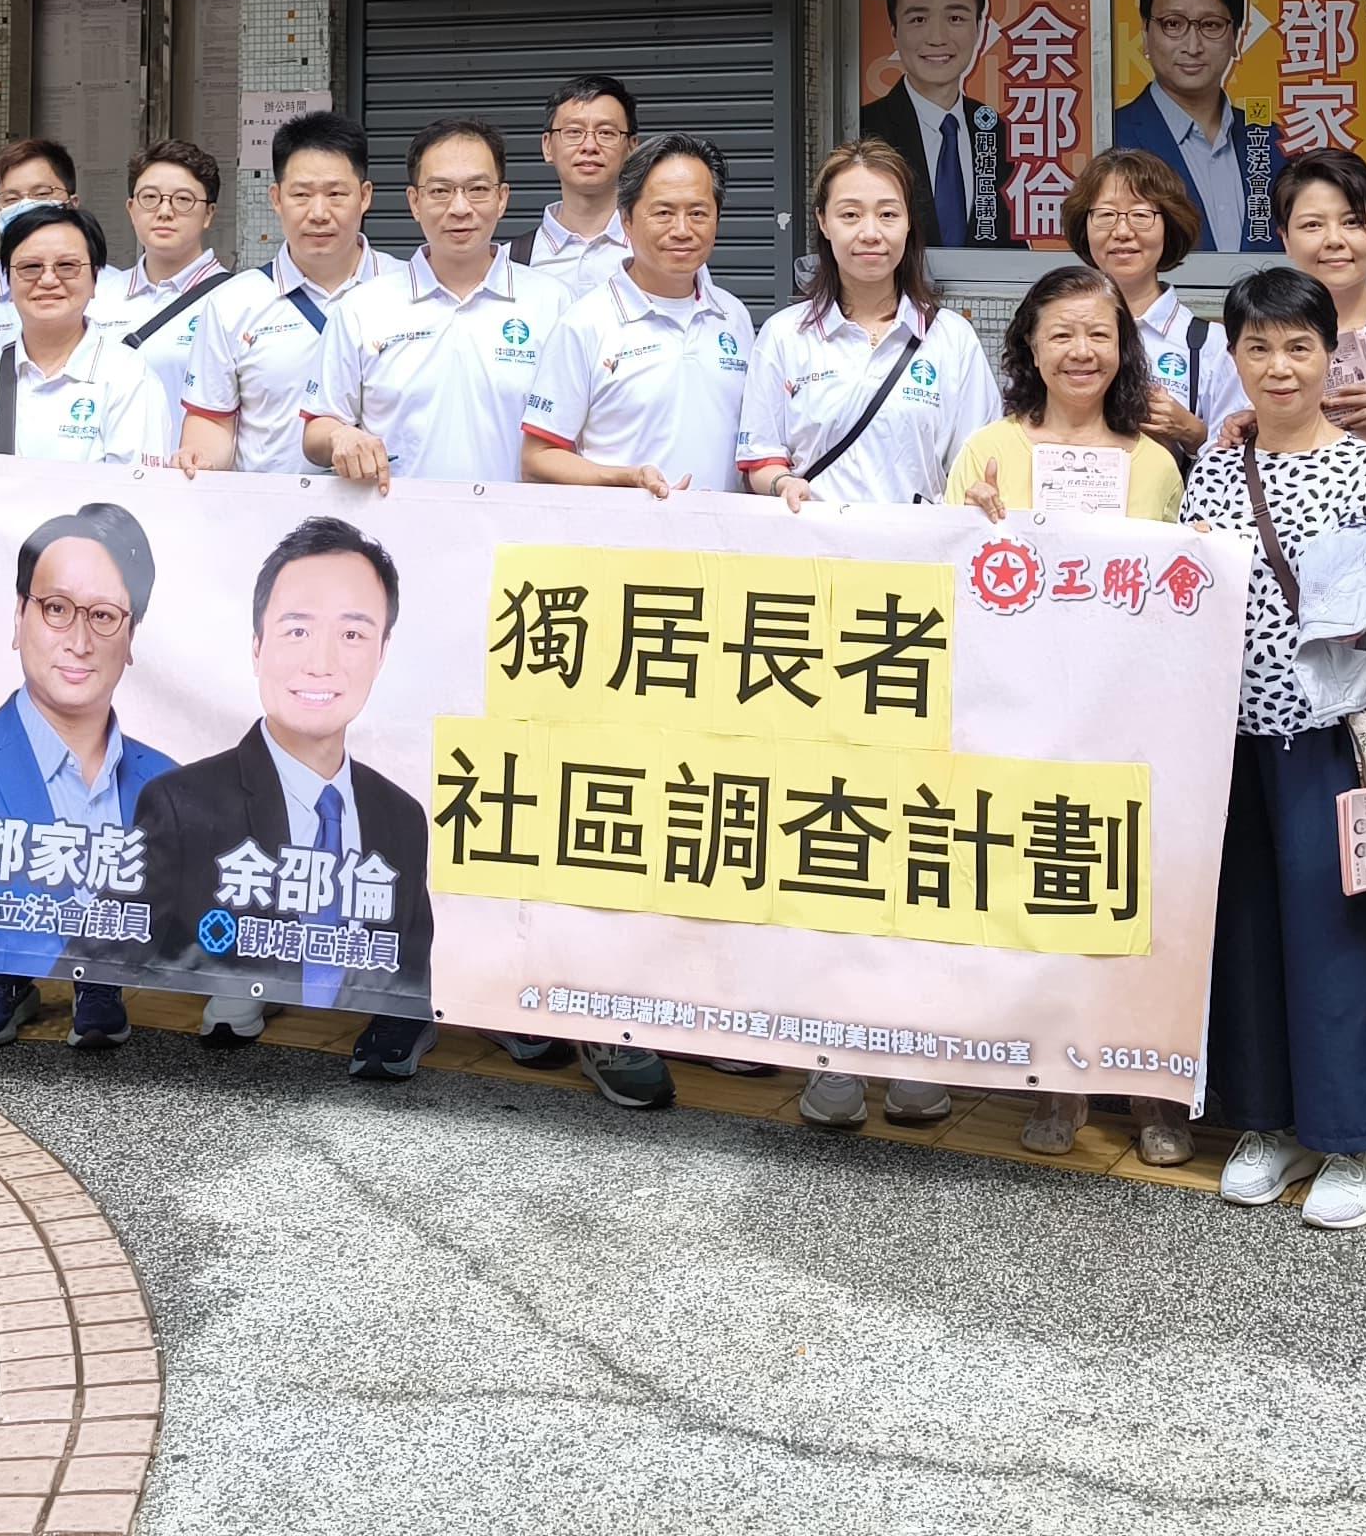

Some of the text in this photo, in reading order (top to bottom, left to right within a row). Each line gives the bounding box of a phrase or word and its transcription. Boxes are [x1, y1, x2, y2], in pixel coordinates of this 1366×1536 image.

[974, 131, 998, 242] 觀塘區議員
[1246, 129, 1273, 243] 立法會議員
[1050, 554, 1215, 612] 工聯會
[489, 580, 948, 719] 獨居長者
[217, 838, 401, 921] 余邵倫
[434, 748, 1143, 923] 社區調查計劃
[237, 917, 401, 971] 觀塘區議員
